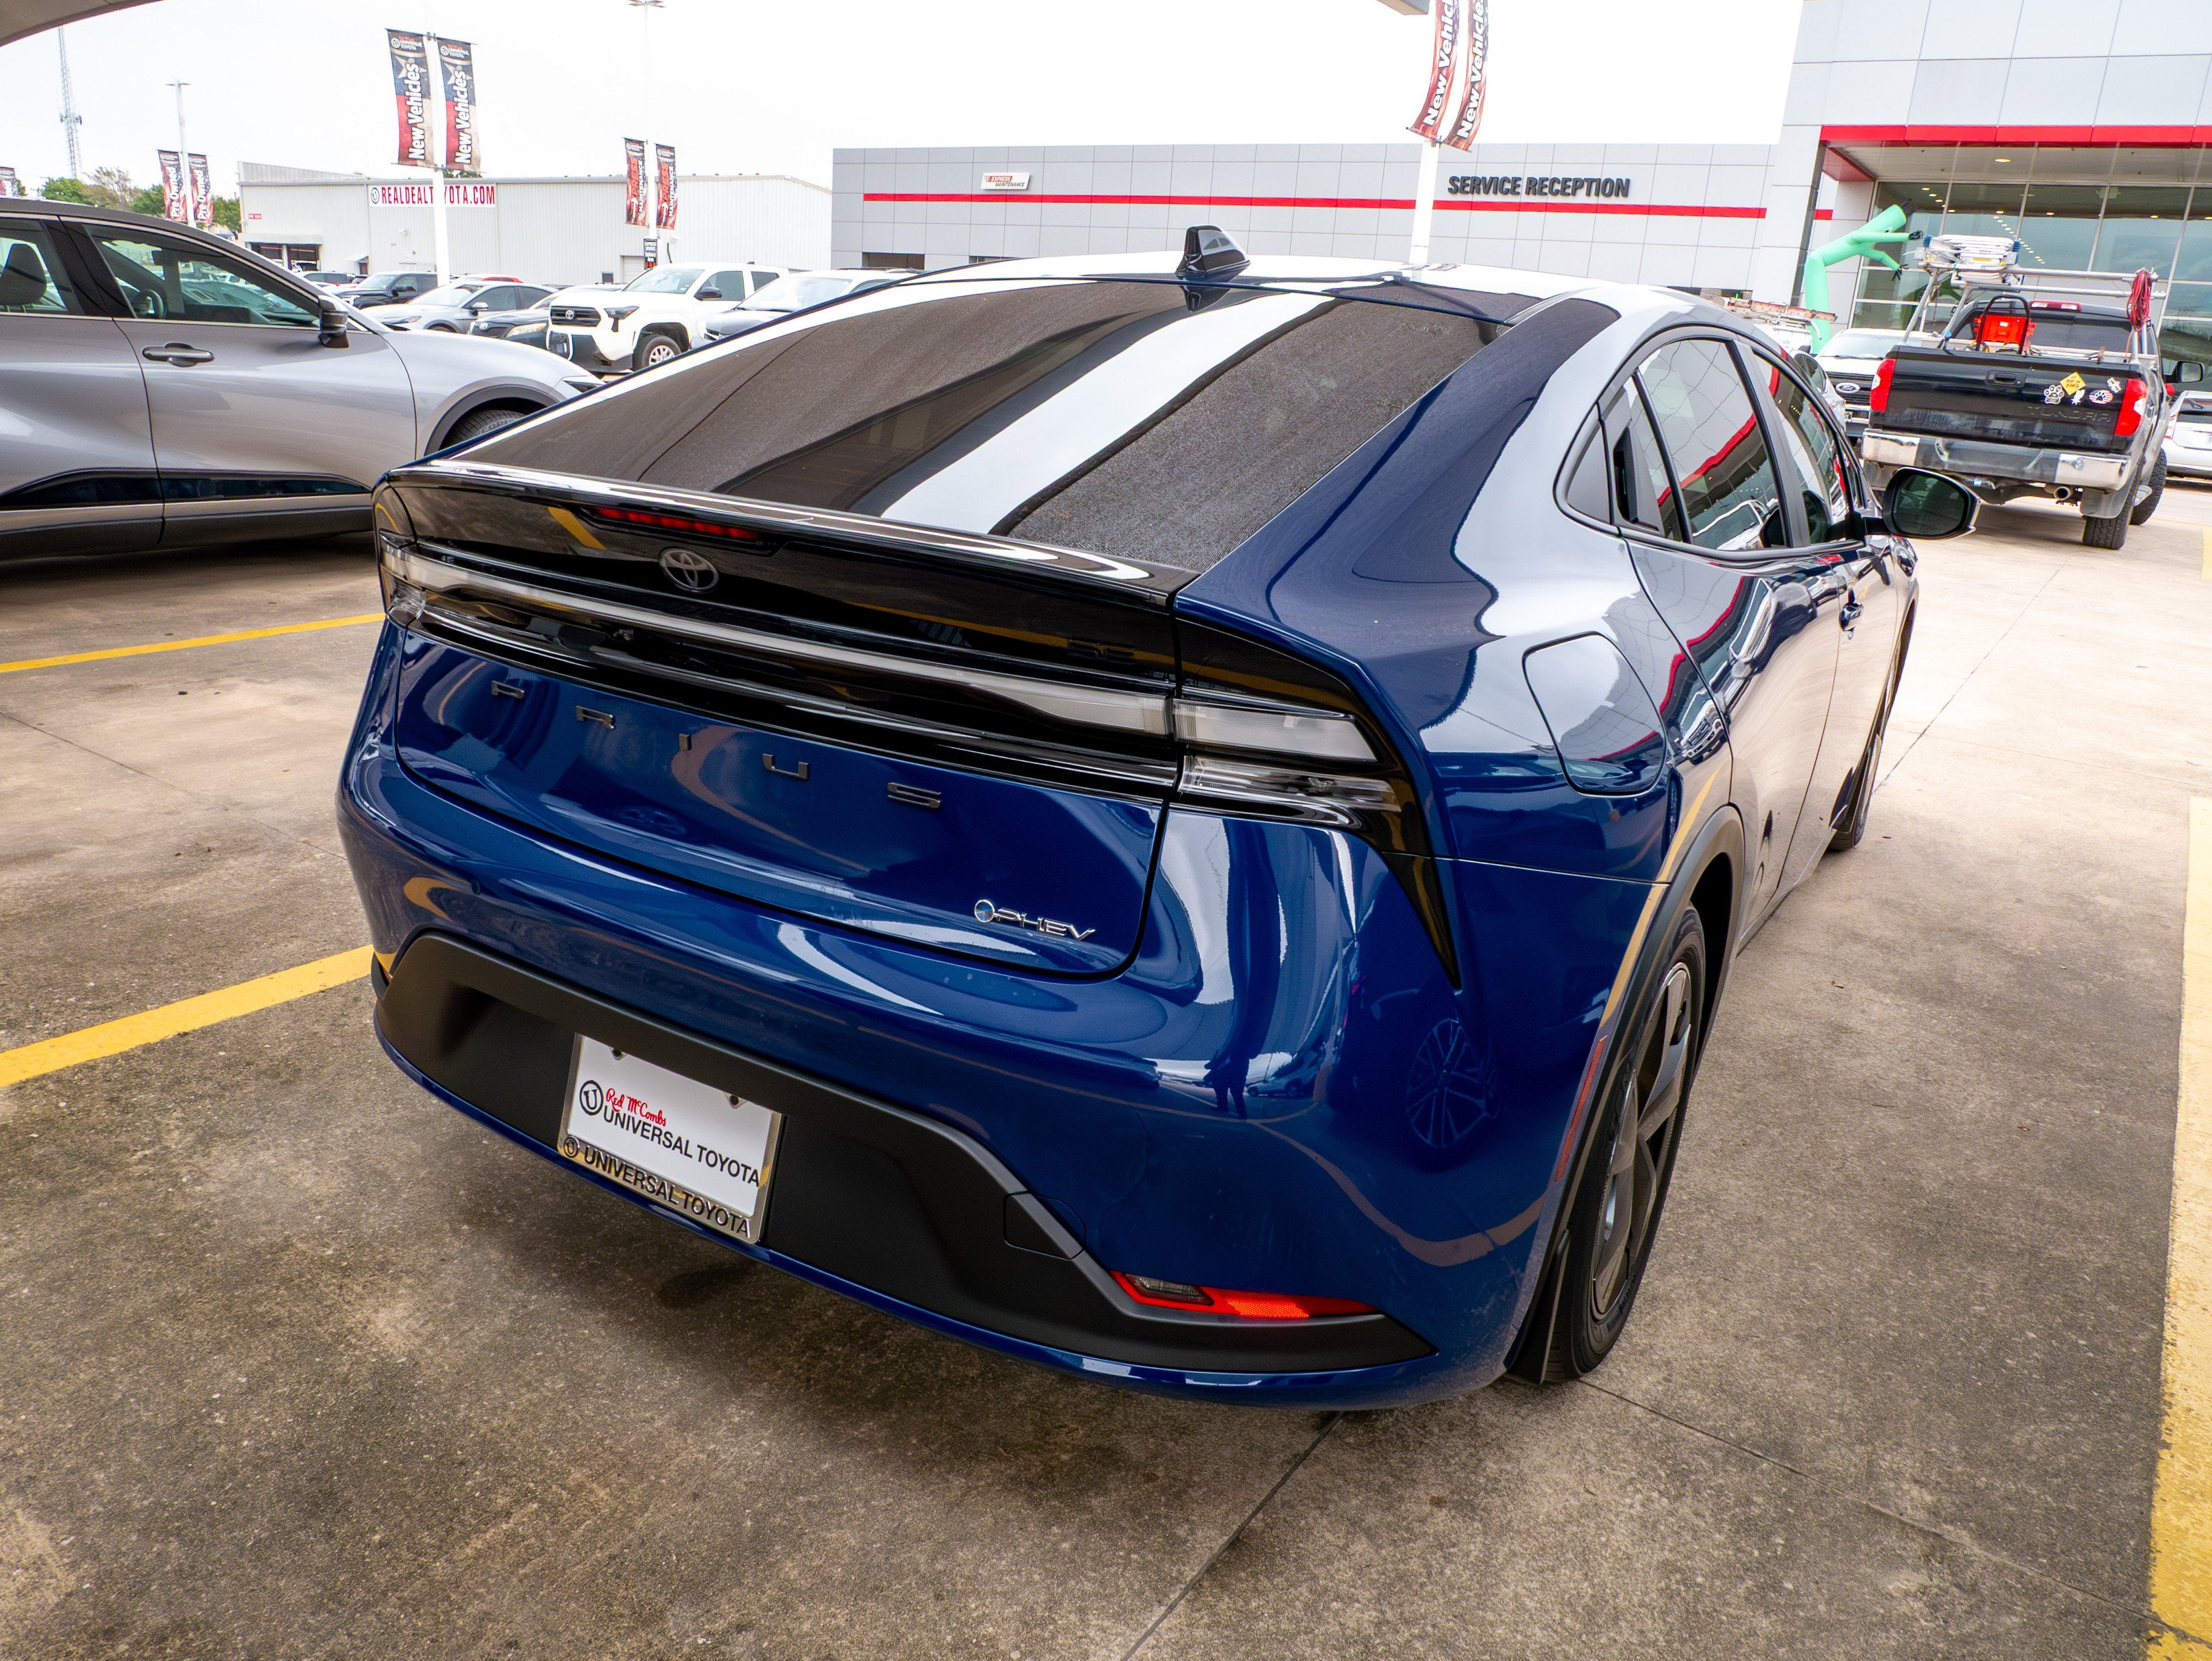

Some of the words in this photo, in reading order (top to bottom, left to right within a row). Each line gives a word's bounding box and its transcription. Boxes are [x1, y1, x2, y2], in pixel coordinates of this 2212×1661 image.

[400, 40, 423, 48] UNIVERSAL
[449, 48, 470, 56] UNIVERSAL
[1423, 73, 1447, 126] New
[1438, 0, 1454, 69] Vehicl
[1456, 88, 1480, 139] New
[1471, 0, 1484, 82] Vehicle
[404, 63, 424, 125] Vehicles
[452, 69, 471, 130] Vehicles
[408, 126, 425, 160] New
[454, 131, 472, 164] New
[166, 167, 179, 200] Owned
[194, 169, 207, 203] Owned
[381, 186, 495, 204] REALDEALTYOTA.COM
[1448, 176, 1522, 195] SERVICE
[1525, 177, 1630, 198] RECEPTION
[171, 202, 180, 218] Pre
[197, 204, 207, 220] Pre
[2027, 405, 2111, 423] TUNDRA
[1066, 638, 1134, 665] SE
[491, 679, 942, 808] PRIUS
[994, 907, 1096, 941] PHEV
[605, 1087, 625, 1113] Red
[626, 1095, 667, 1127] McCombs
[604, 1105, 694, 1159] UNIVERSAL
[697, 1144, 761, 1187] TOYOTA
[584, 1144, 680, 1205] UNIVERSAL
[682, 1189, 751, 1238] TOYOTA
